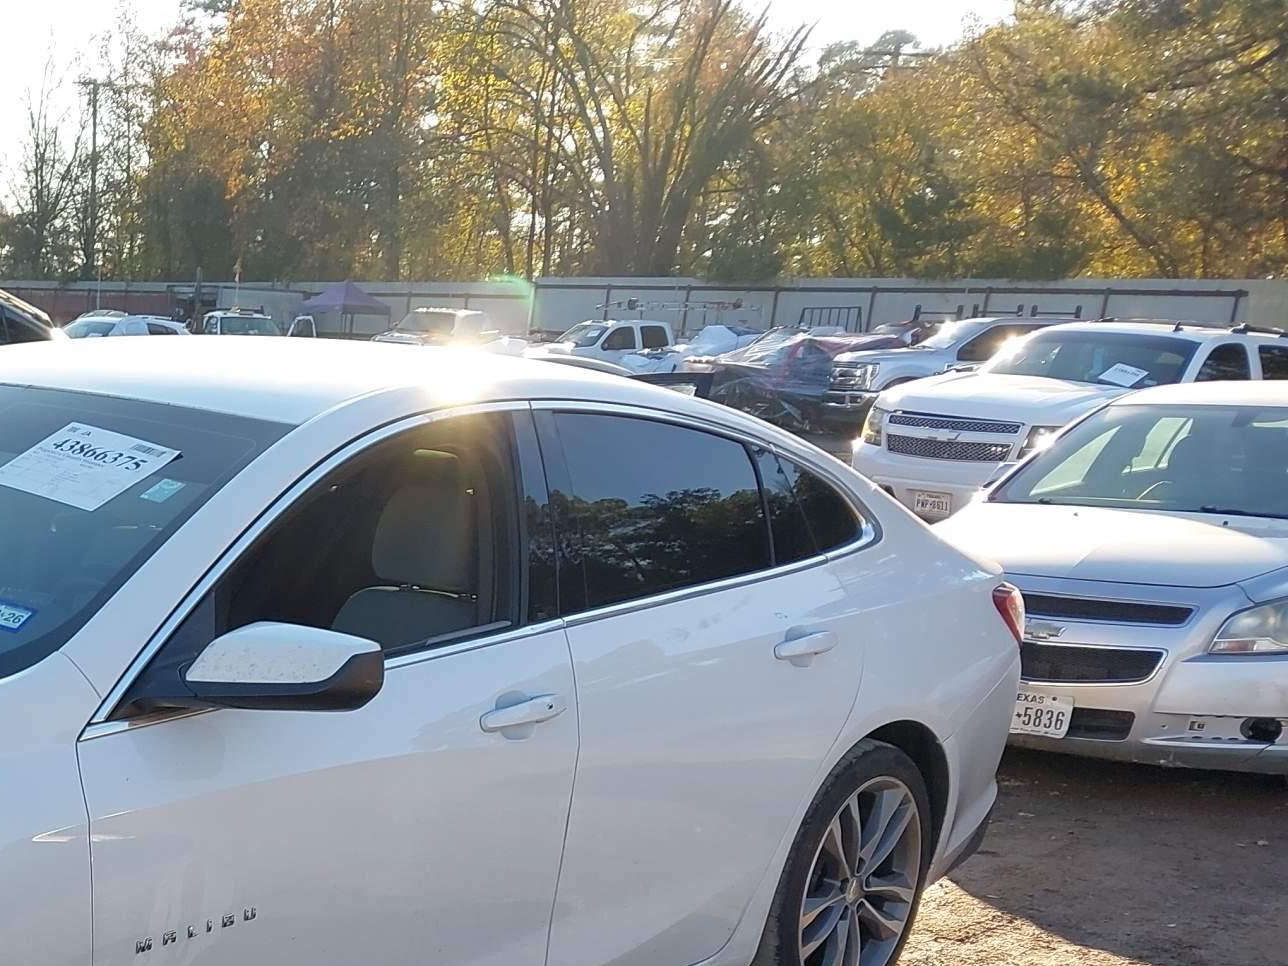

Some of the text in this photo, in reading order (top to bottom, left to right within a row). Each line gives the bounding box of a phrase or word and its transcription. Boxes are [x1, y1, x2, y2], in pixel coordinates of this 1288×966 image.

[52, 438, 148, 471] 43866375
[1016, 693, 1045, 704] EXAS
[135, 907, 257, 954] MALIBU
